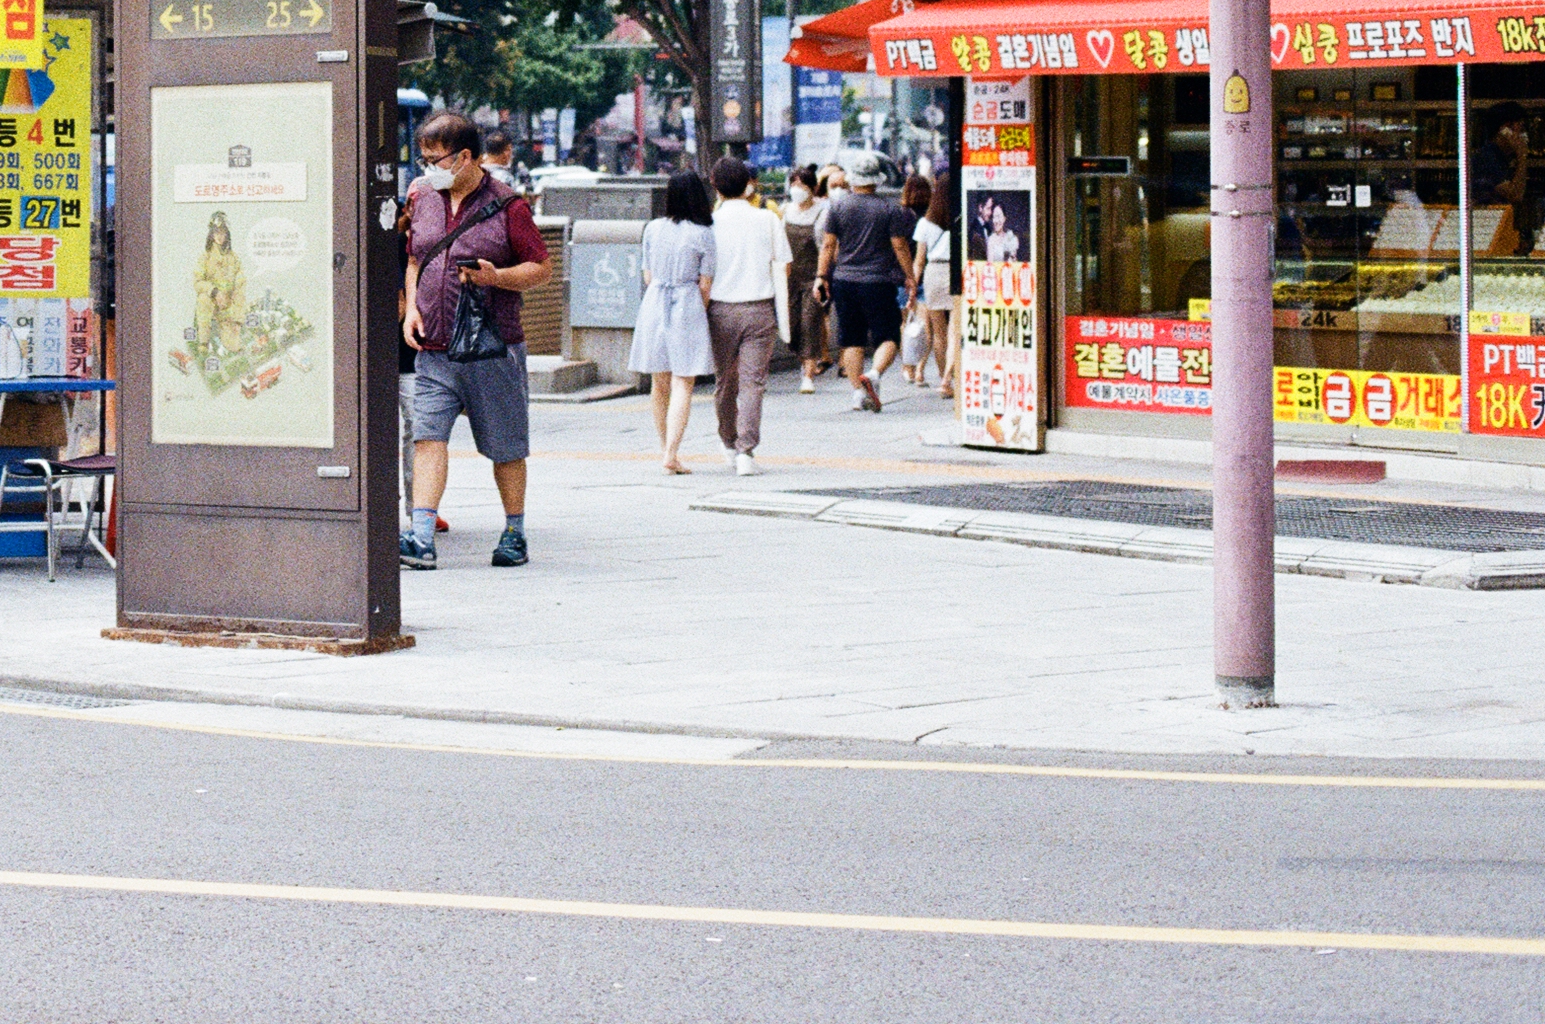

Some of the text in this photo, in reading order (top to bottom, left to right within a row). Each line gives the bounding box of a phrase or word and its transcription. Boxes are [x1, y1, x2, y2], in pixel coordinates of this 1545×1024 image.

[192, 0, 292, 32] 15 25
[885, 39, 938, 71] PT백금
[951, 33, 992, 73] 알콩
[996, 32, 1080, 70] 결혼기념일
[1122, 27, 1170, 70] 달콩
[1292, 22, 1340, 65] 심쿵
[1345, 19, 1428, 60] 프로포즈
[1430, 16, 1476, 58] 반지
[34, 152, 81, 170] 500회
[33, 173, 79, 190] 667회
[1079, 319, 1155, 340] 결혼기념일
[1074, 341, 1212, 385] 결혼예물전
